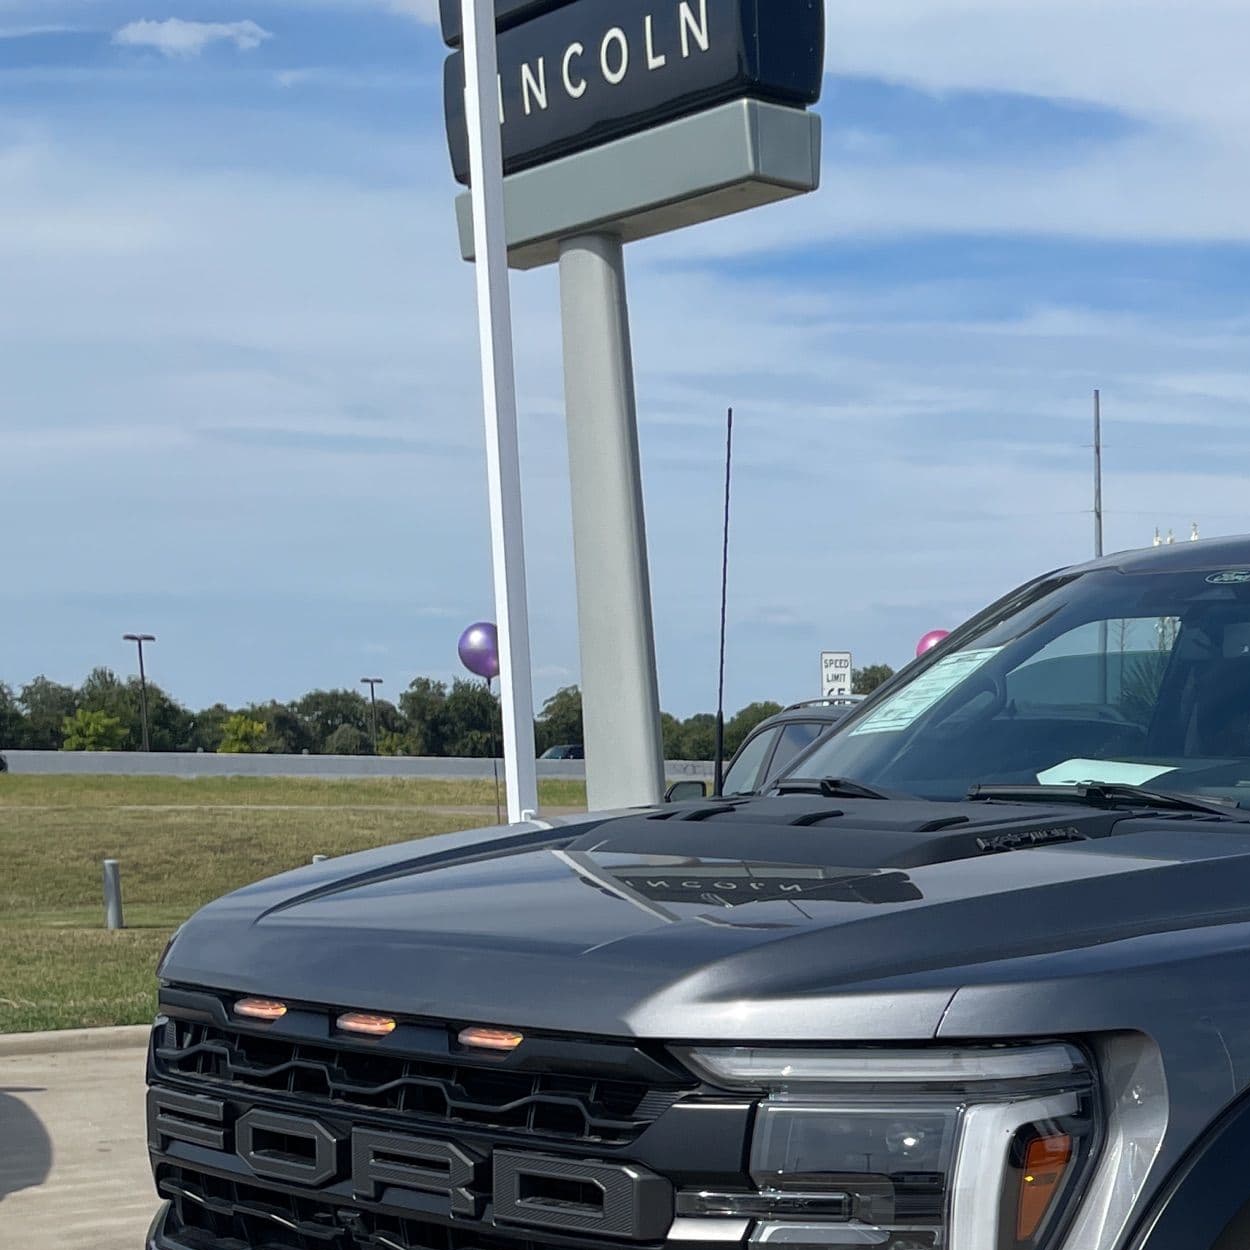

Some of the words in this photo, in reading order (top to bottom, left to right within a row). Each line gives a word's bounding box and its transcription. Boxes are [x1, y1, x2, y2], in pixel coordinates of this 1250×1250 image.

[464, 0, 711, 135] INCOLN
[824, 658, 849, 669] SPEED
[826, 673, 846, 683] LIMIT
[147, 1086, 655, 1240] FORD
